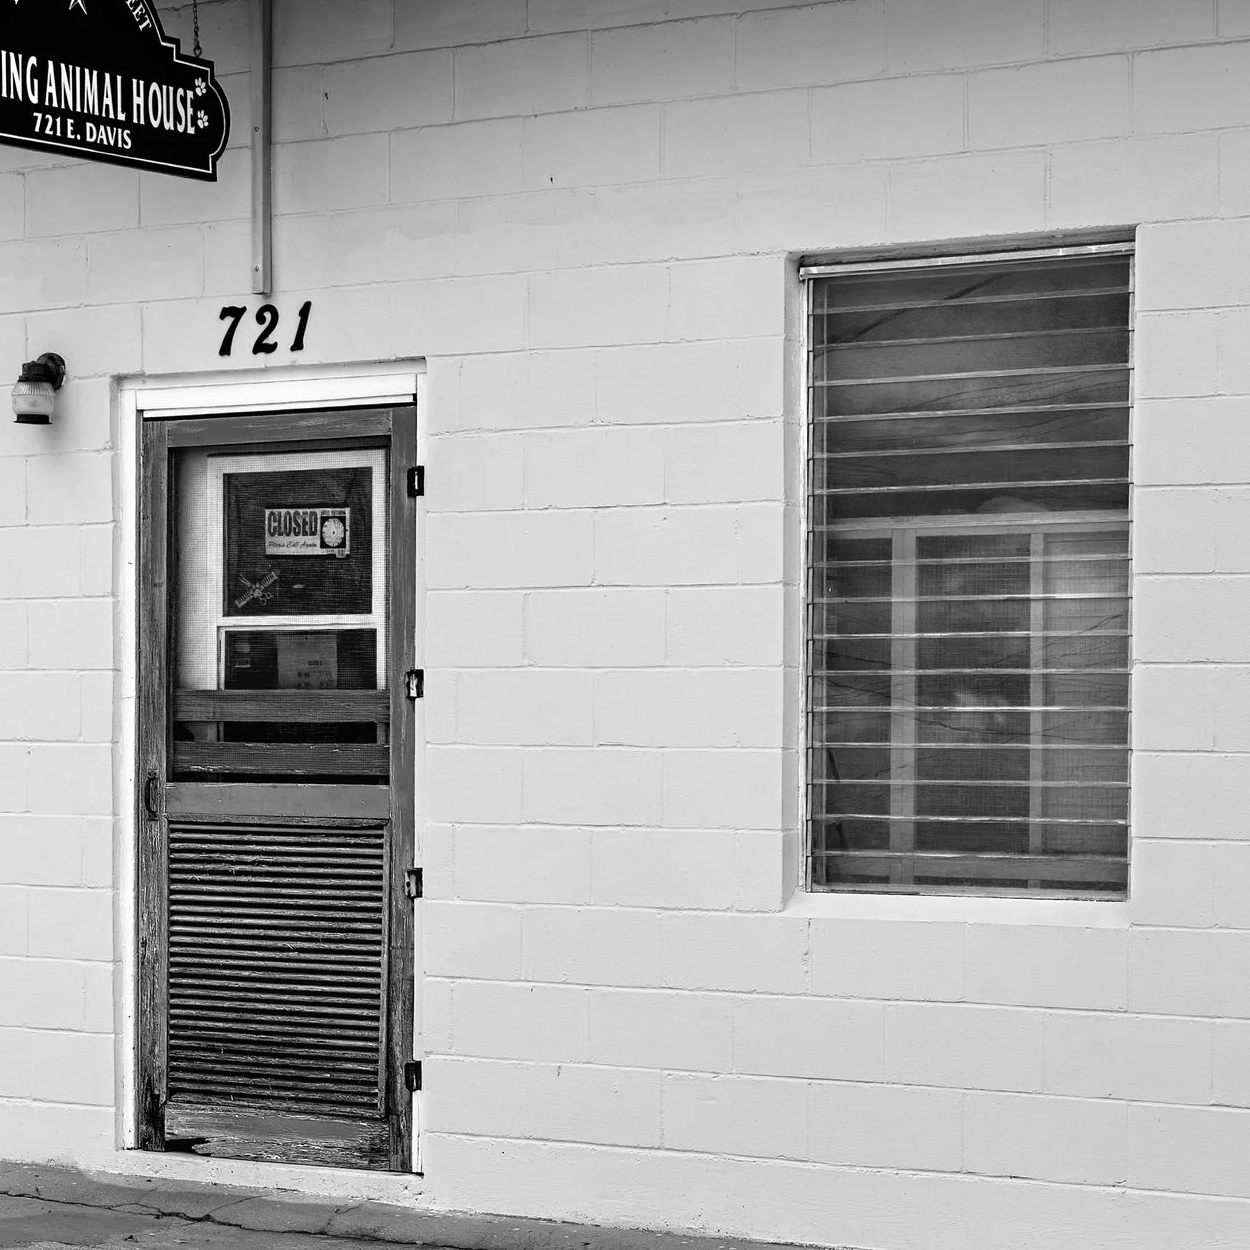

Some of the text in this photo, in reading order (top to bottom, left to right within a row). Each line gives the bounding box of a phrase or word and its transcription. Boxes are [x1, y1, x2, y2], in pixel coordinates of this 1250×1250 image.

[45, 59, 126, 121] ANIMAL
[132, 78, 196, 135] HOUSE
[33, 111, 132, 150] 721 E. DAVIS
[218, 300, 312, 357] 721
[267, 510, 318, 537] CLOSED
